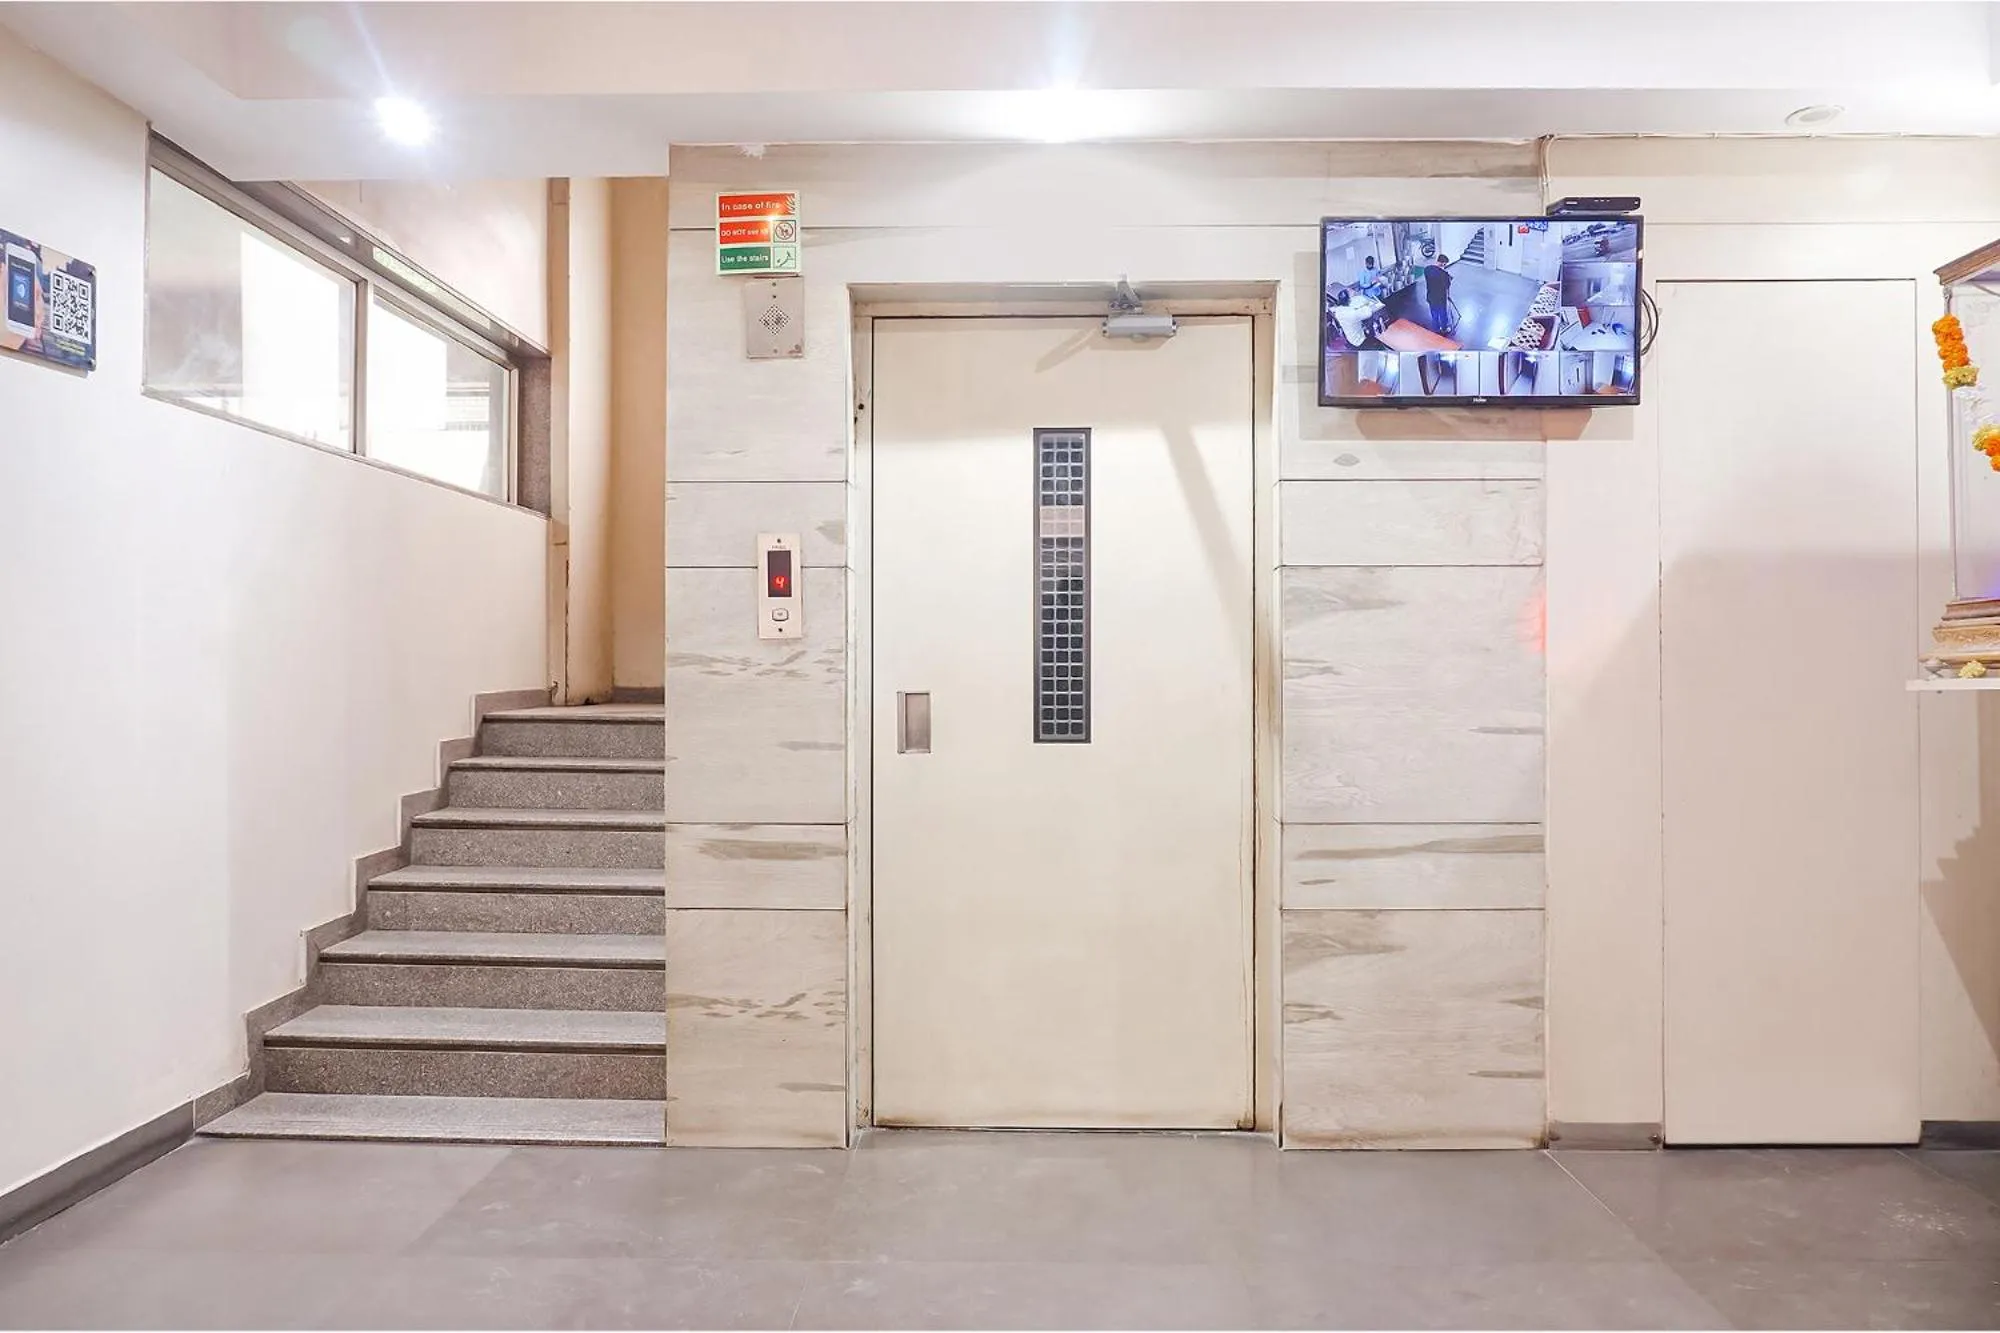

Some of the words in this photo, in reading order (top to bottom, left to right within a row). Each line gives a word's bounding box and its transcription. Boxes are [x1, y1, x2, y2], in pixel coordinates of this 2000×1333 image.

[722, 203, 731, 211] In
[766, 201, 780, 209] fire
[721, 256, 735, 264] Use
[736, 255, 748, 263] the
[749, 253, 769, 262] stairs
[775, 576, 785, 589] 4
